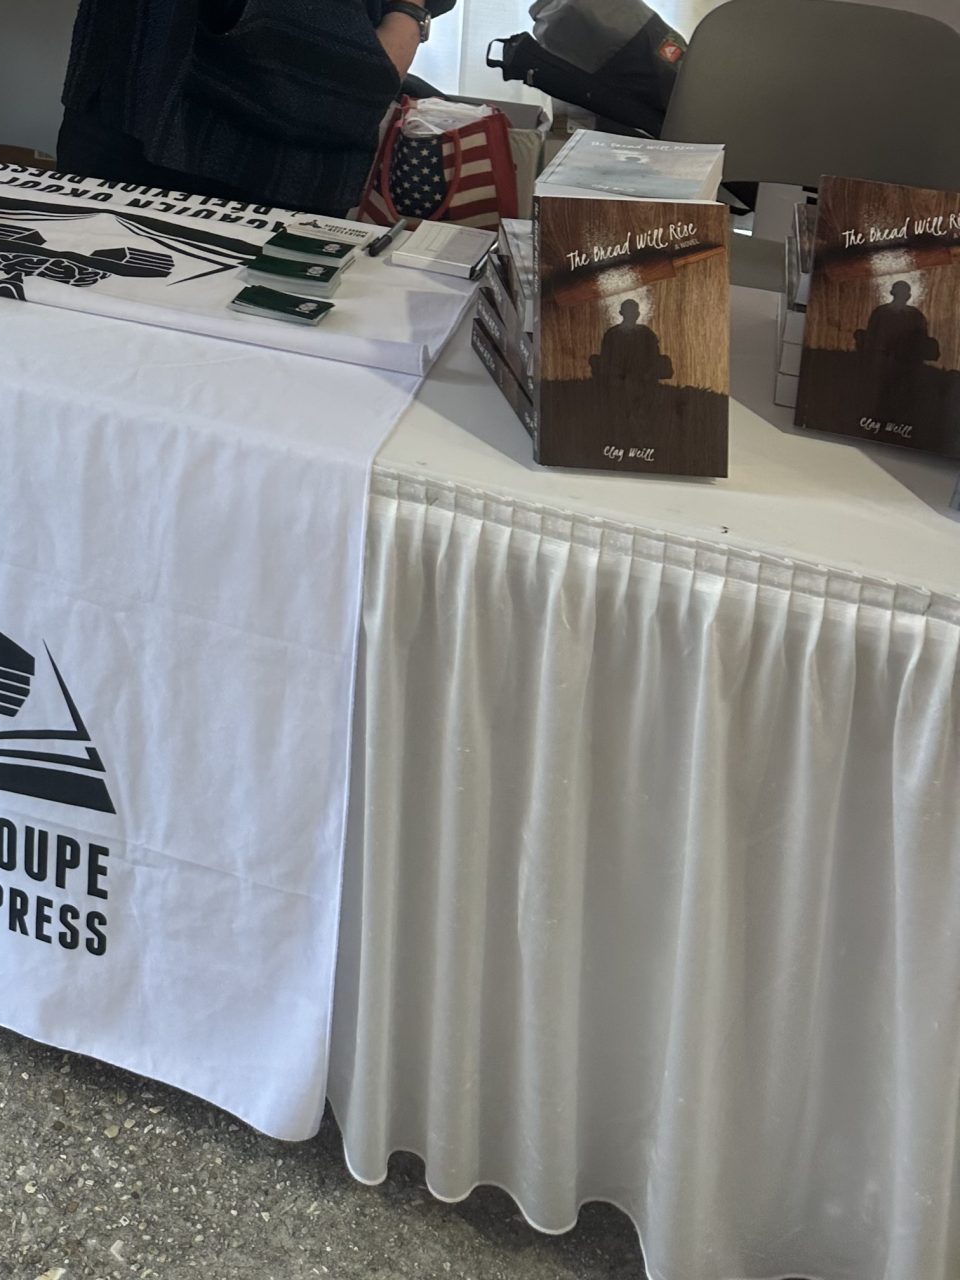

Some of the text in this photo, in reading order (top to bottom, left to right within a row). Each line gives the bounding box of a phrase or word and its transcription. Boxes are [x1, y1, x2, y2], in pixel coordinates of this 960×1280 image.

[566, 221, 698, 271] The Bread Will Rise
[842, 229, 866, 249] The
[869, 217, 910, 243] Bread
[915, 216, 947, 236] Will
[859, 417, 913, 439] Clay Weill
[603, 445, 655, 462] Clay Weill
